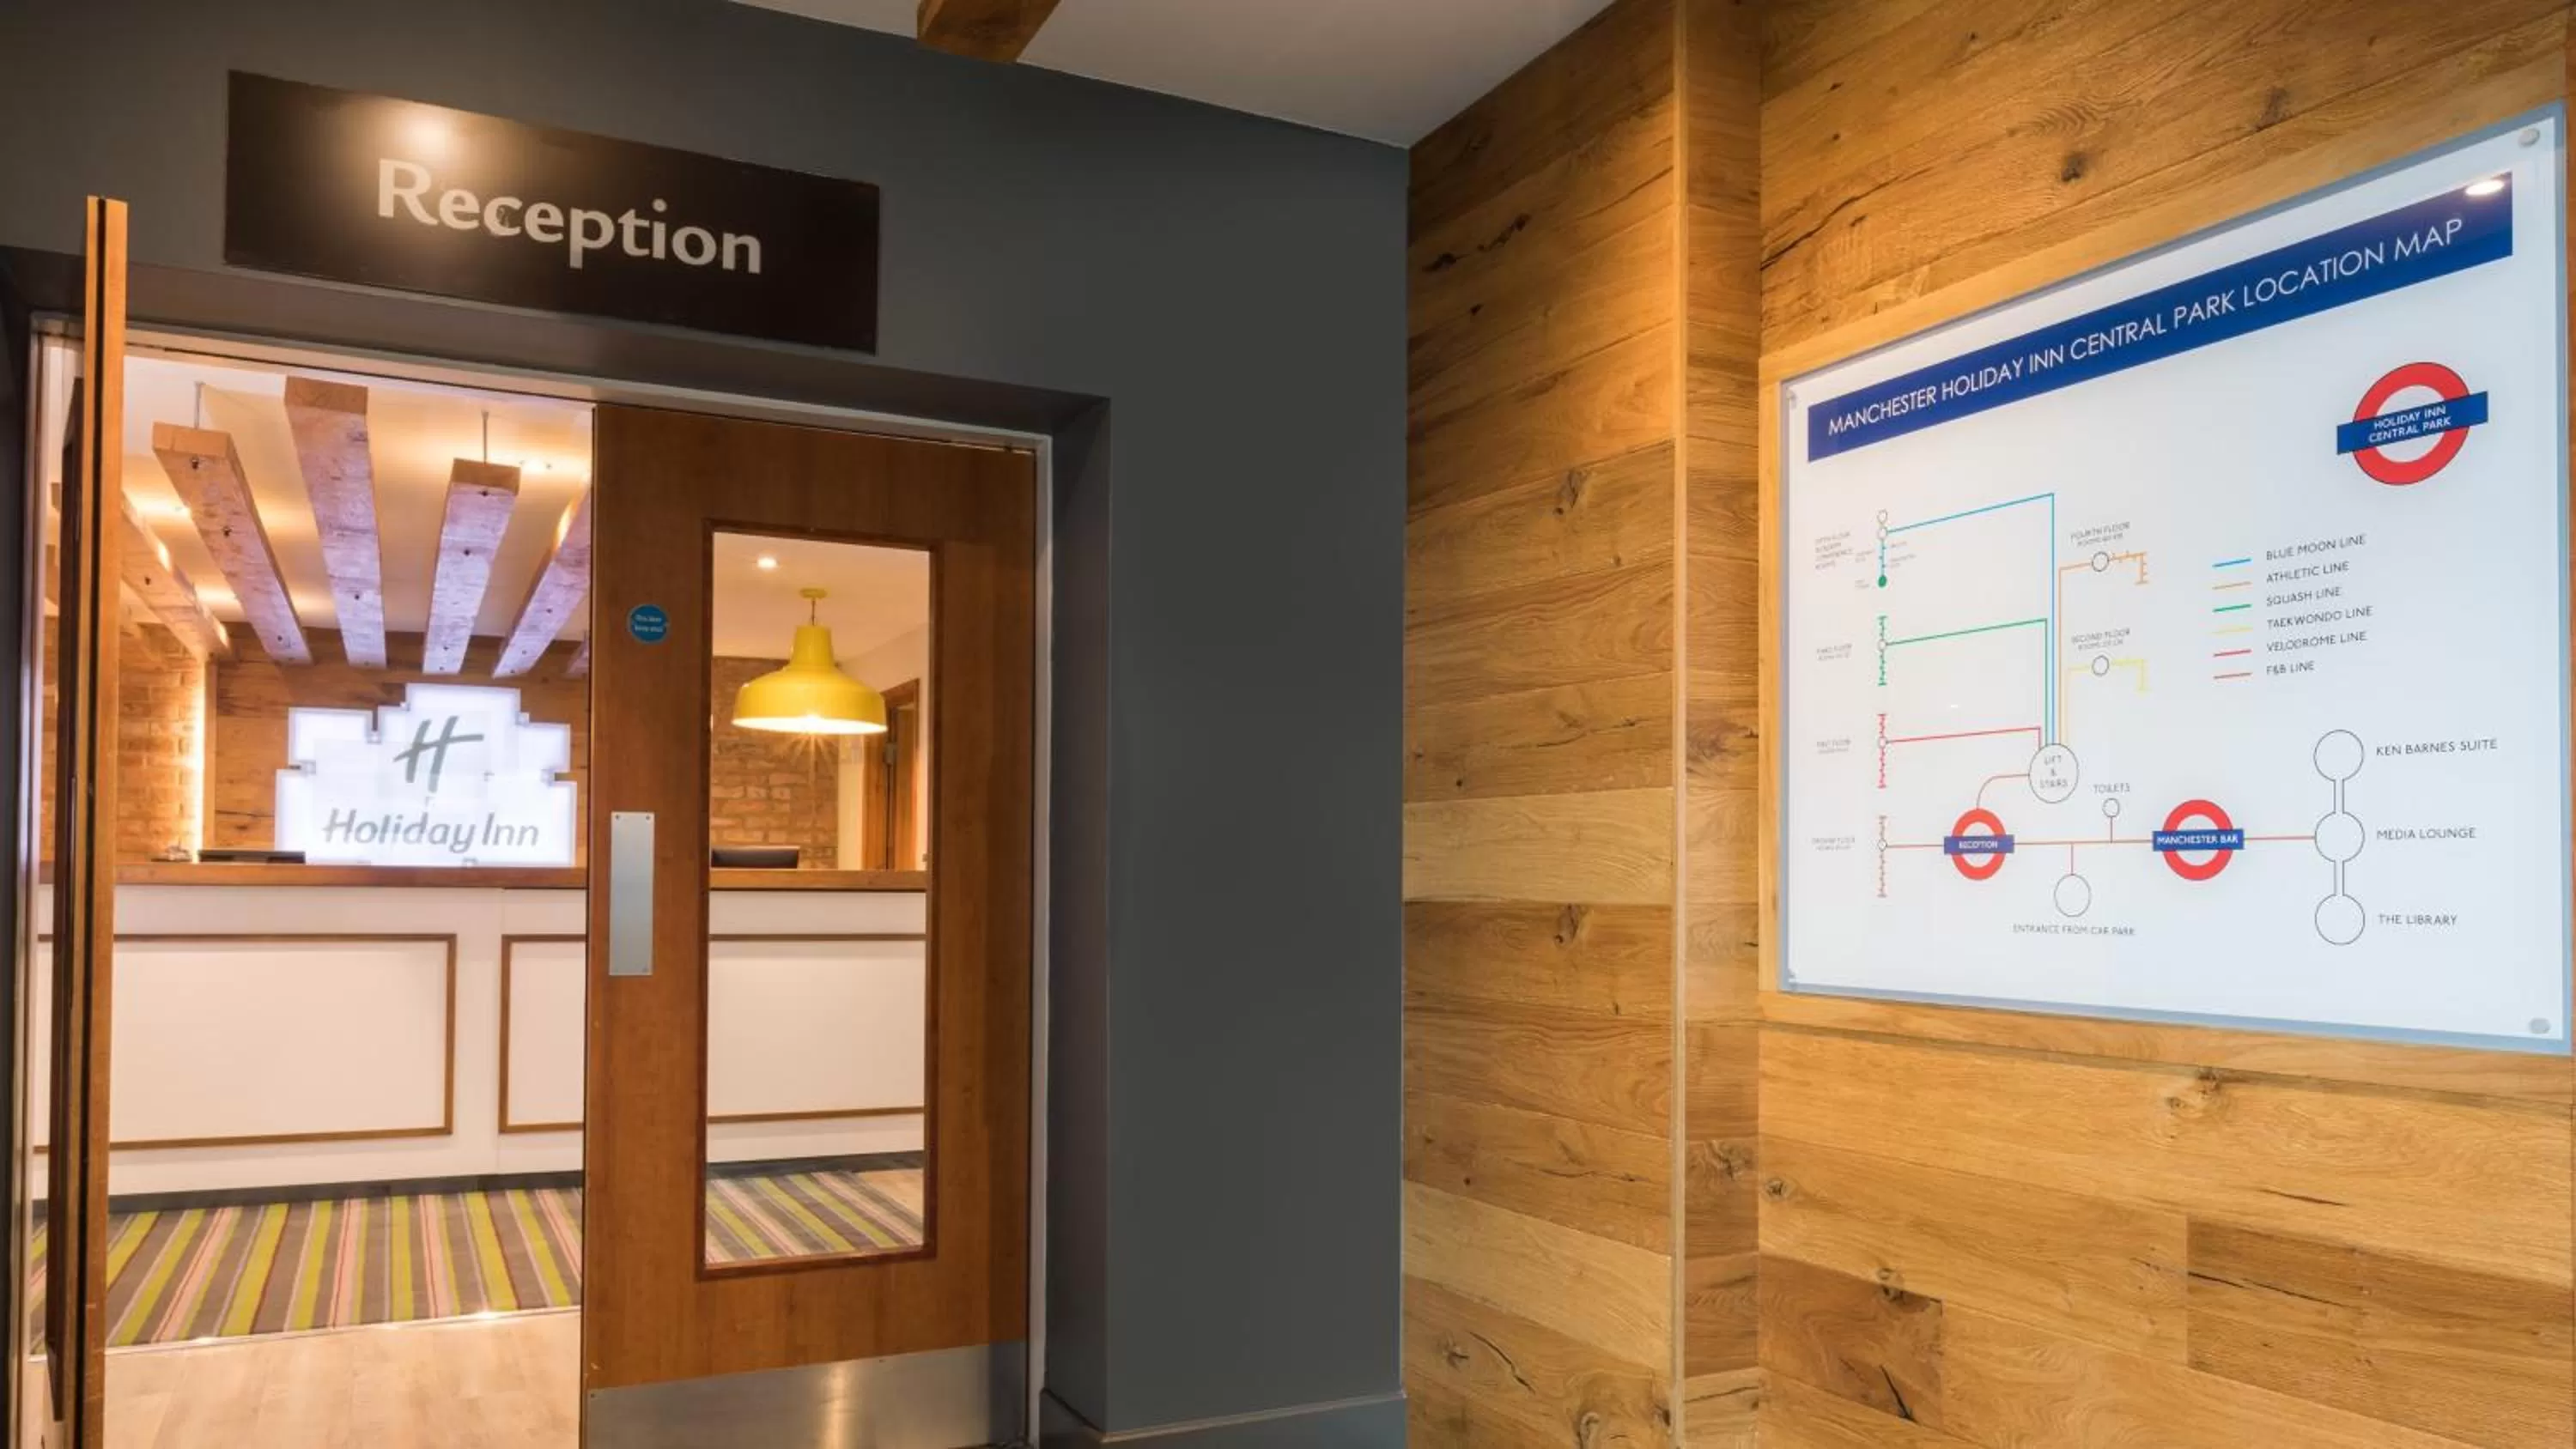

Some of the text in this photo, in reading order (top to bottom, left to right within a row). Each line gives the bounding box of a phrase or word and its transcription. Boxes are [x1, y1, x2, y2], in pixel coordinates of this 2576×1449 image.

[378, 158, 762, 275] Reception
[1827, 217, 2463, 436] MANCHESTER HOLIDAY INN CENTRAL PARK LOCATION MAP
[2373, 404, 2447, 430] HOLIDAY INN
[2368, 415, 2452, 443] CENTRAL PARK
[2266, 532, 2367, 561] BLUE MOON LINE
[2266, 561, 2350, 584] ATHLETIC LINE
[2266, 586, 2342, 606] SQUASH LINE
[2267, 605, 2373, 629] TAEKWONDO LINE
[2266, 631, 2367, 652] VELODROME LINE
[2266, 660, 2315, 676] F&B LINE
[2376, 738, 2498, 756] KEN BARNES SUITE
[322, 808, 539, 854] Holiday Inn
[2156, 834, 2239, 845] MANCHESTER BAR
[2376, 828, 2477, 840] MEDIA LOUNGE
[2378, 914, 2458, 926] THE LIBRARY
